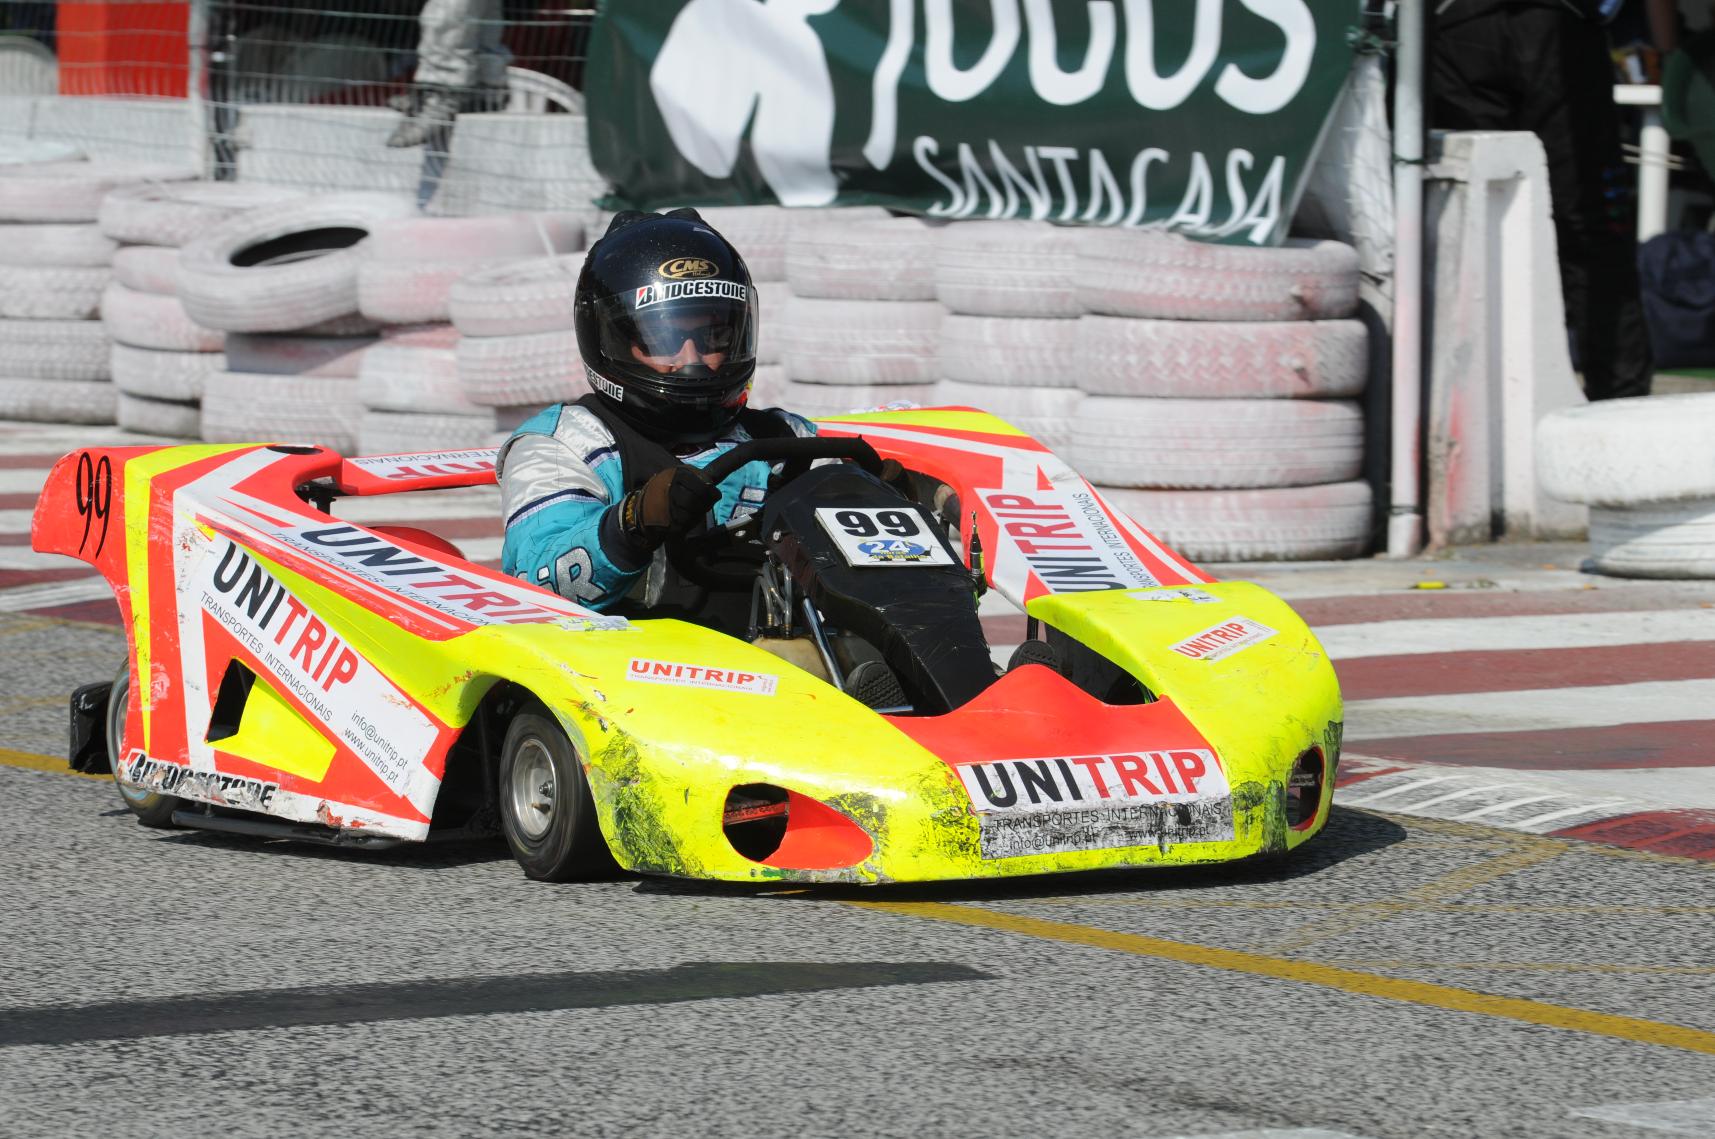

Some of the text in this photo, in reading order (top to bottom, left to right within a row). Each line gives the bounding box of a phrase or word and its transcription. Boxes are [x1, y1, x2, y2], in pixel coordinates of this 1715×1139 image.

[669, 259, 709, 273] CMS
[76, 451, 112, 560] 99
[835, 510, 920, 537] 99
[986, 494, 1128, 592] UNITRIP
[213, 541, 359, 692] UNITRIP
[1173, 622, 1249, 658] UNITRIP
[201, 591, 333, 721] TRANSPORTES INTERNACIONAIS
[631, 660, 755, 685] UNITRIP
[344, 727, 399, 783] www.unitrip.pt
[351, 709, 408, 770] info@unitrip.pt
[970, 751, 1206, 809] UNITRIP
[993, 802, 1223, 831] TRANSPORTES INTERNACNAIS
